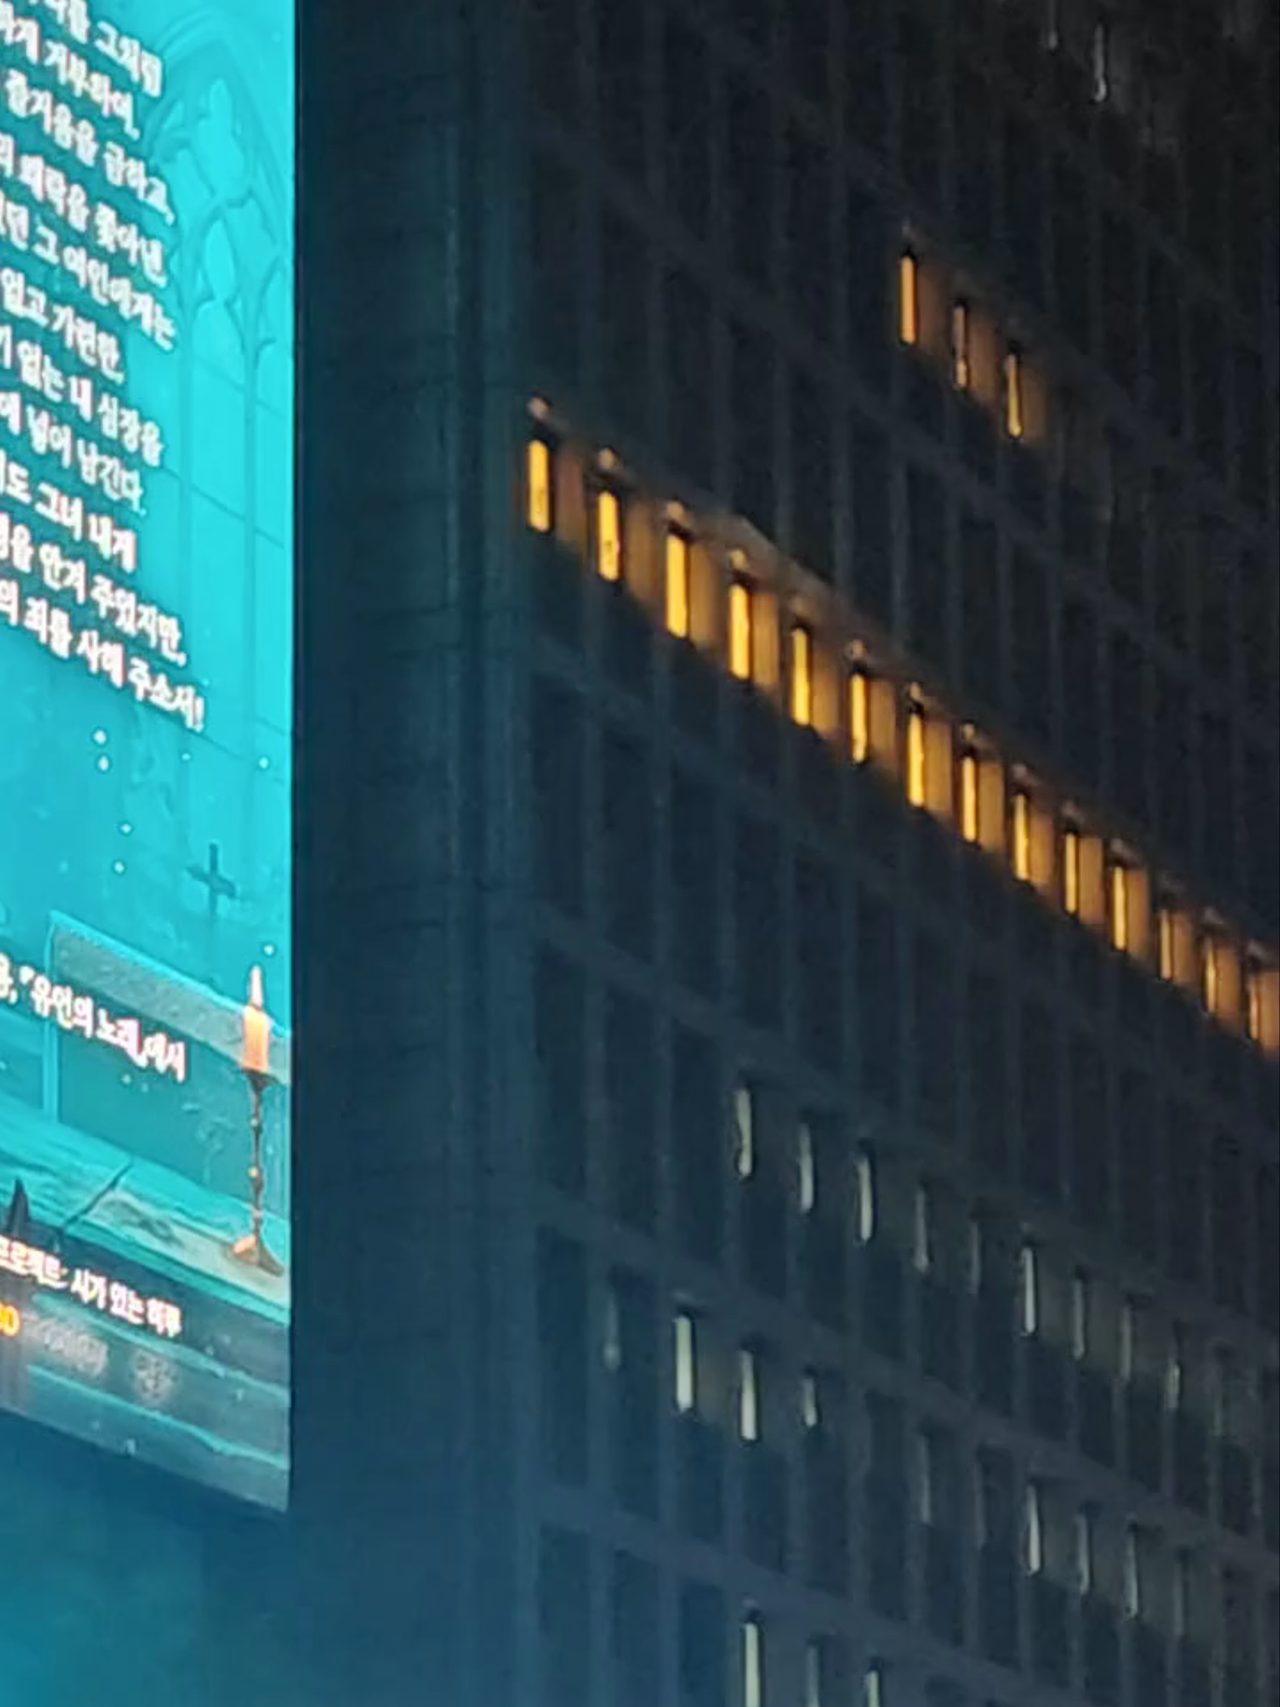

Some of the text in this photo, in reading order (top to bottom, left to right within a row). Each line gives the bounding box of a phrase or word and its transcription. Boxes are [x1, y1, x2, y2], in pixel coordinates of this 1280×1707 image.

[5, 67, 99, 167] 즐거움을
[103, 141, 175, 226] 금하고,
[0, 267, 49, 327] 없고
[33, 225, 59, 264] 그
[62, 245, 176, 352] 여인에게는
[17, 340, 65, 402] 없는
[69, 376, 93, 422] 내
[97, 392, 164, 467] 심장을
[25, 404, 72, 469] 넣어
[77, 438, 147, 517] 남긴다.
[35, 482, 83, 542] 그녀
[89, 513, 137, 574] 내게
[23, 597, 72, 660] 죄를
[77, 629, 124, 689] 사해
[128, 656, 204, 732] 주소서!
[39, 543, 87, 605] 안겨
[91, 574, 187, 667] 주었지만,
[70, 1267, 108, 1310] 시가
[109, 1280, 146, 1325] 있는
